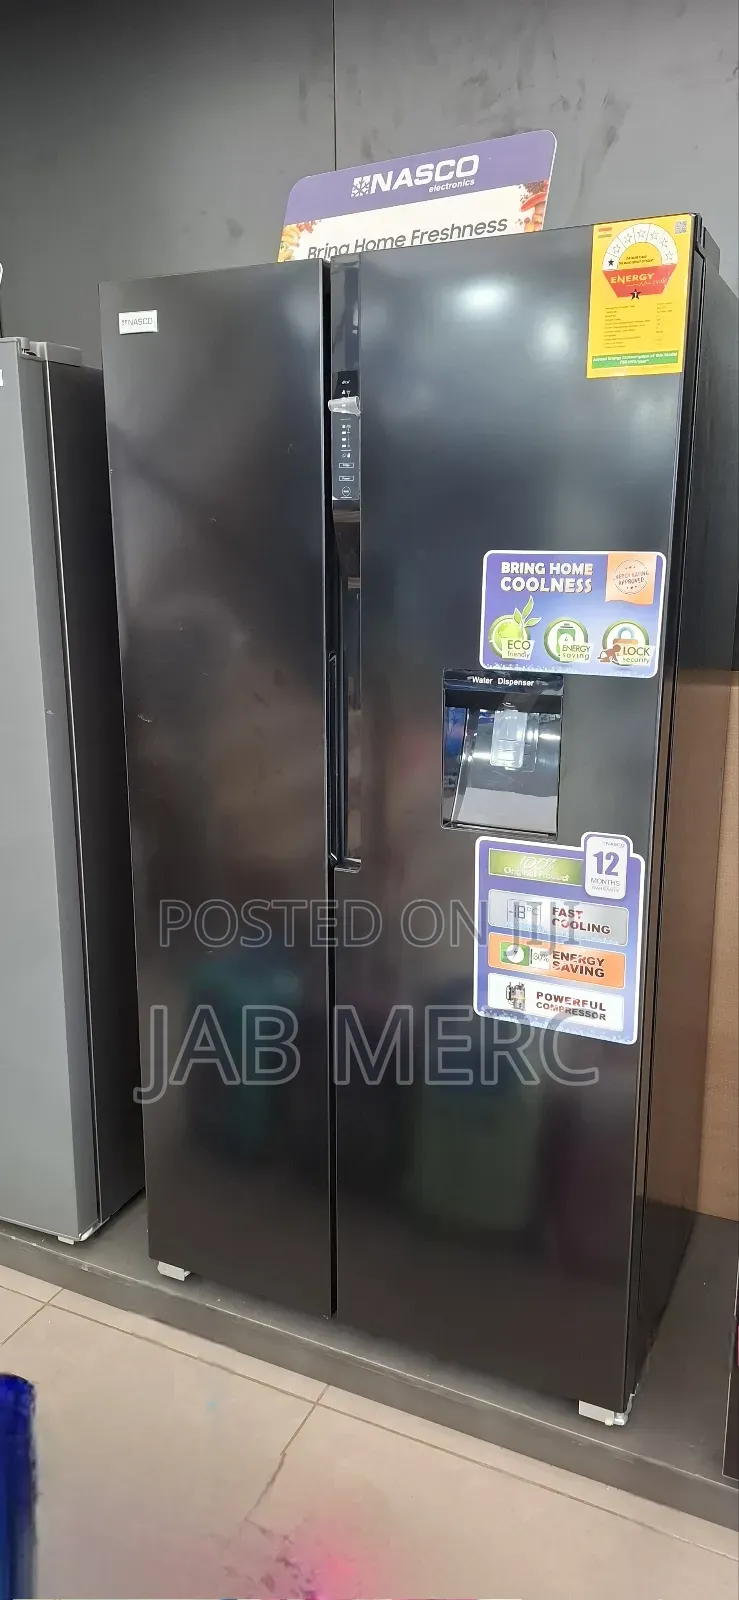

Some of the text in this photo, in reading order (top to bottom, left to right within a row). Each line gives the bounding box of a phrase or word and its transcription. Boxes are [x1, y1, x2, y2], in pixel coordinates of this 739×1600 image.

[370, 154, 479, 195] NASCO
[428, 178, 475, 193] electronics
[354, 232, 407, 252] Home
[410, 217, 508, 245] Freshness
[610, 272, 655, 285] ENERGY
[127, 317, 153, 326] NASCO
[500, 561, 593, 576] BRING HOME
[500, 577, 593, 594] COOLNESS
[507, 640, 531, 650] ECO
[562, 644, 590, 653] ENERGY
[623, 646, 650, 656] LOCK
[507, 651, 530, 659] friendly
[622, 656, 650, 664] security
[472, 676, 535, 686] Water Dispenser
[592, 850, 620, 877] 12
[590, 877, 621, 887] MONTHS
[552, 906, 584, 920] FAST
[551, 918, 611, 935] COOLING
[552, 950, 605, 967] ENERGY
[552, 960, 605, 978] SAVING
[536, 991, 606, 1012] POWERFUL
[536, 1001, 606, 1021] COMPRESSOR
